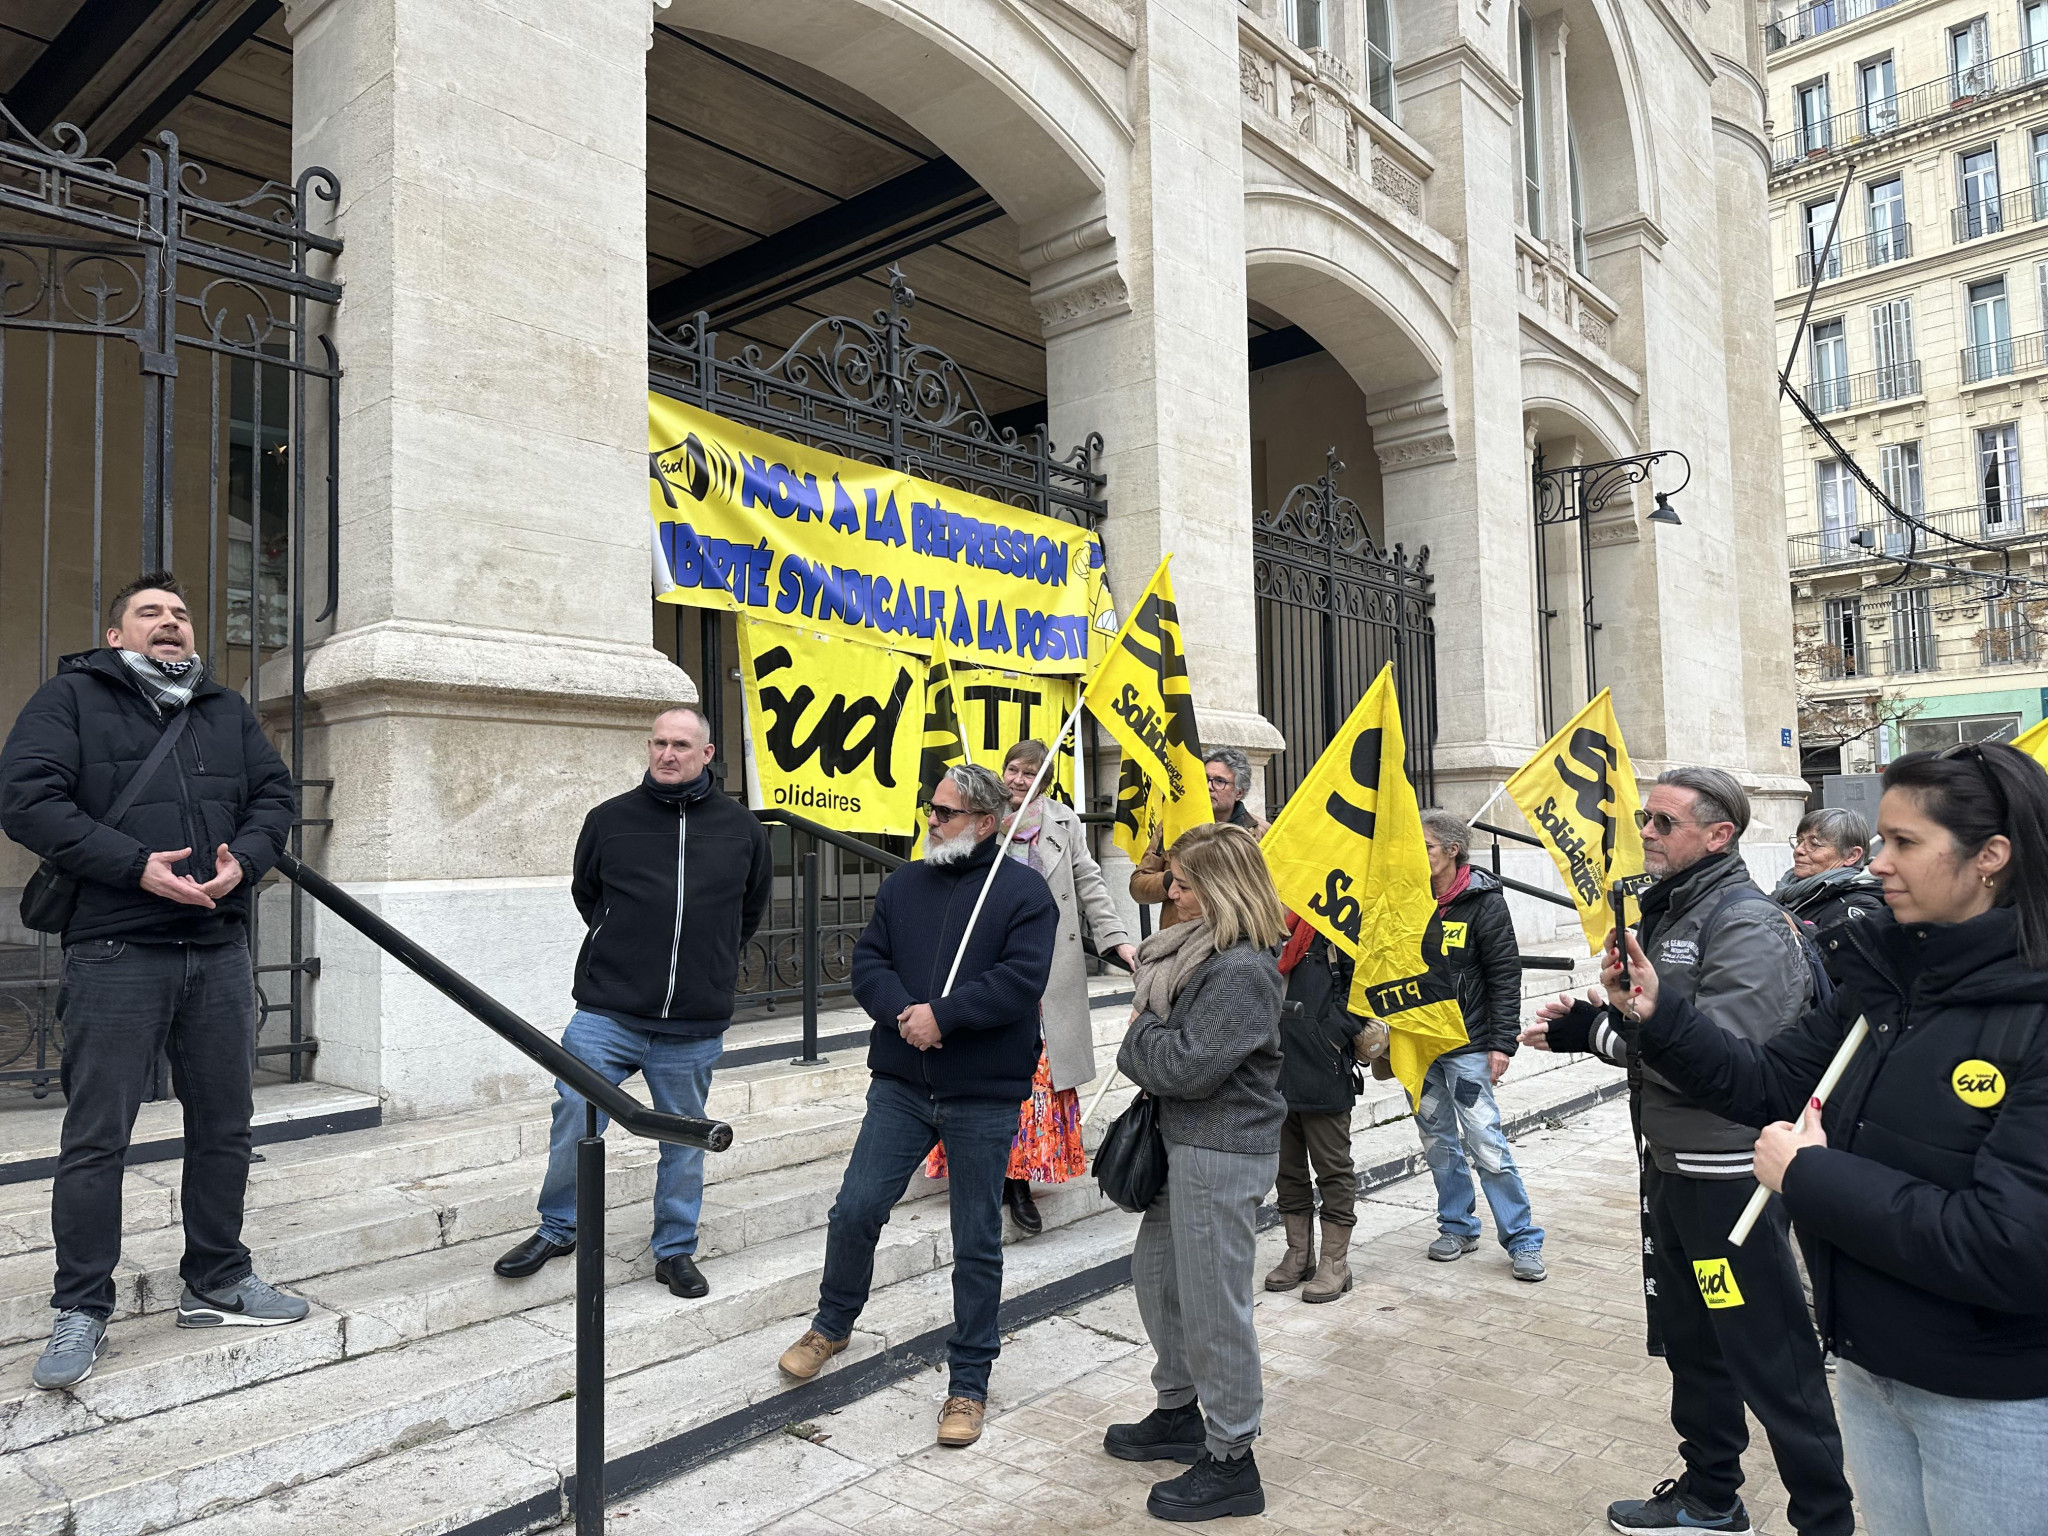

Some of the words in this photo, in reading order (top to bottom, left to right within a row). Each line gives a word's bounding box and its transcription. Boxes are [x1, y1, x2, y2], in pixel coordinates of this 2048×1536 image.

[739, 451, 823, 522] NON
[829, 472, 860, 535] À
[864, 488, 906, 548] LA
[911, 498, 1068, 587] RÉPRESSION
[660, 521, 774, 607] IBRTÉ
[775, 554, 946, 640] SYNDICALE
[949, 585, 974, 647] À
[978, 600, 1012, 654] LA
[964, 686, 1041, 750] TT
[774, 784, 861, 812] olidaires
[1534, 796, 1600, 907] Solidaires
[1443, 925, 1464, 940] ud
[1957, 1073, 1998, 1093] Sud
